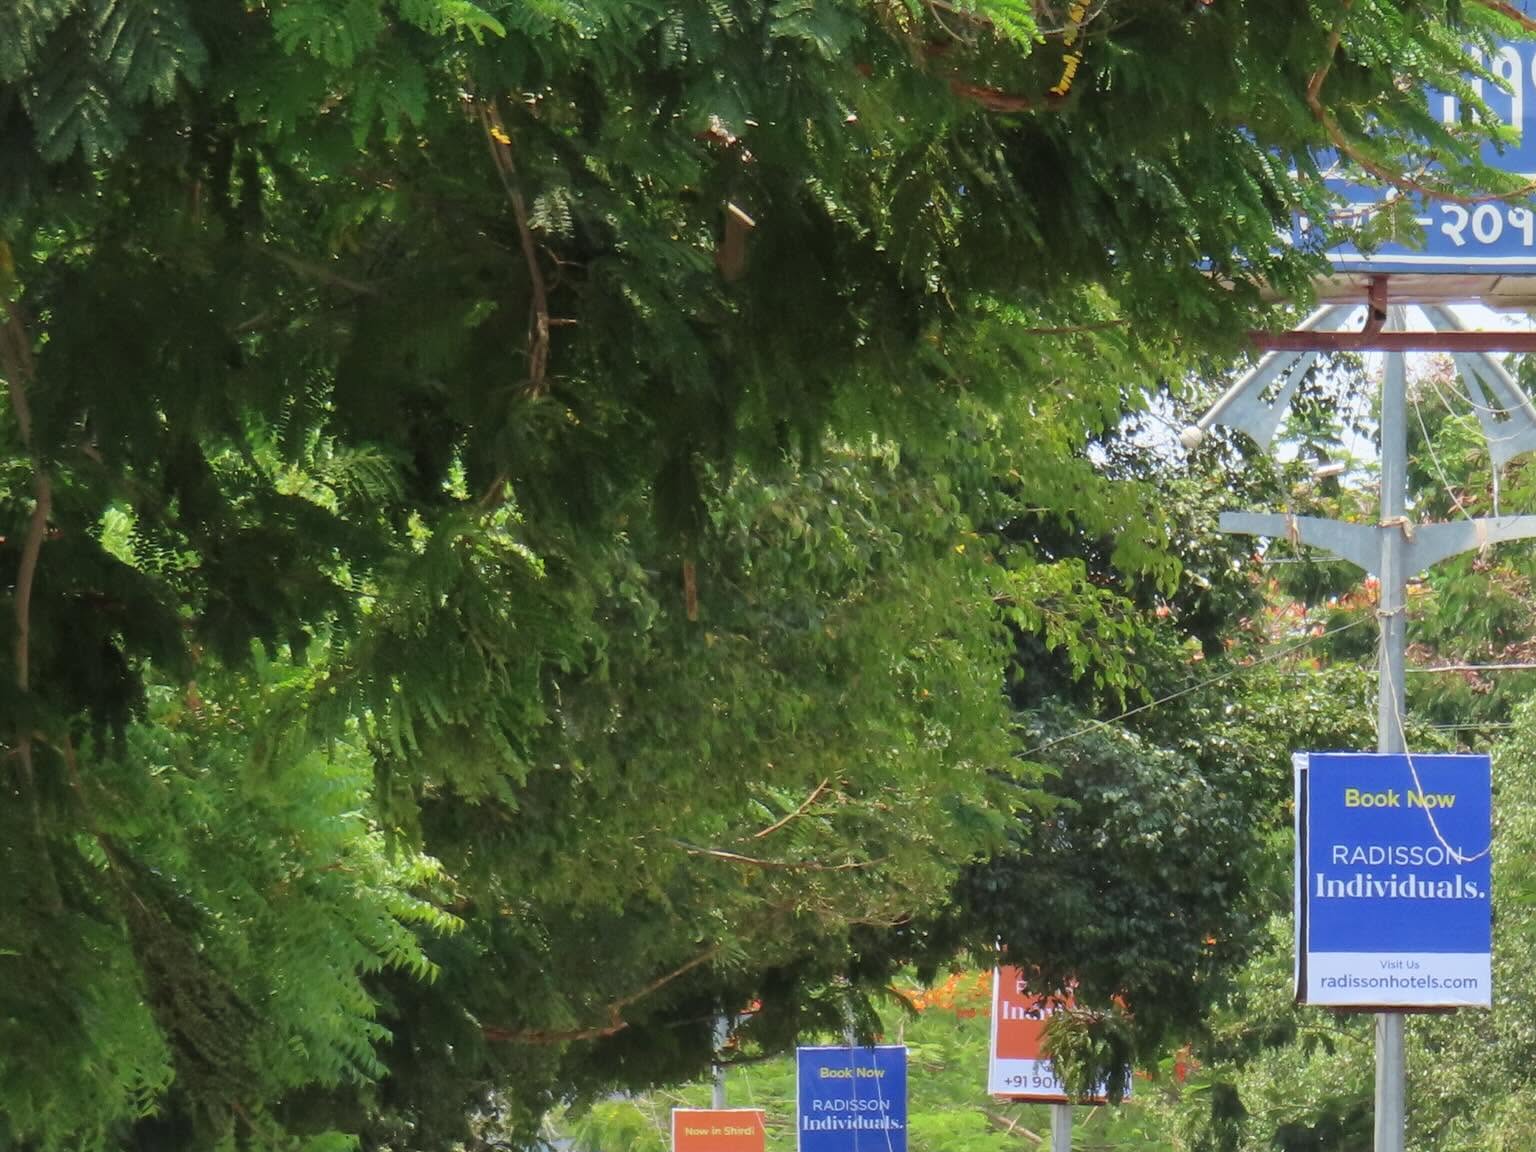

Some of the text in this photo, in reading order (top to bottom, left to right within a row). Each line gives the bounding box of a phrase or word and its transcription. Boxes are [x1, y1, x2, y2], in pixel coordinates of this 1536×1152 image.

[1344, 788, 1456, 809] Book Now
[1332, 845, 1463, 866] RADISSON
[1315, 873, 1486, 899] Individuals.
[1379, 960, 1420, 970] Visit Us
[1320, 974, 1479, 990] radissonhotels.com
[819, 1066, 886, 1079] Book Now
[1004, 1076, 1028, 1089] +91
[812, 1099, 891, 1112] RADISSON
